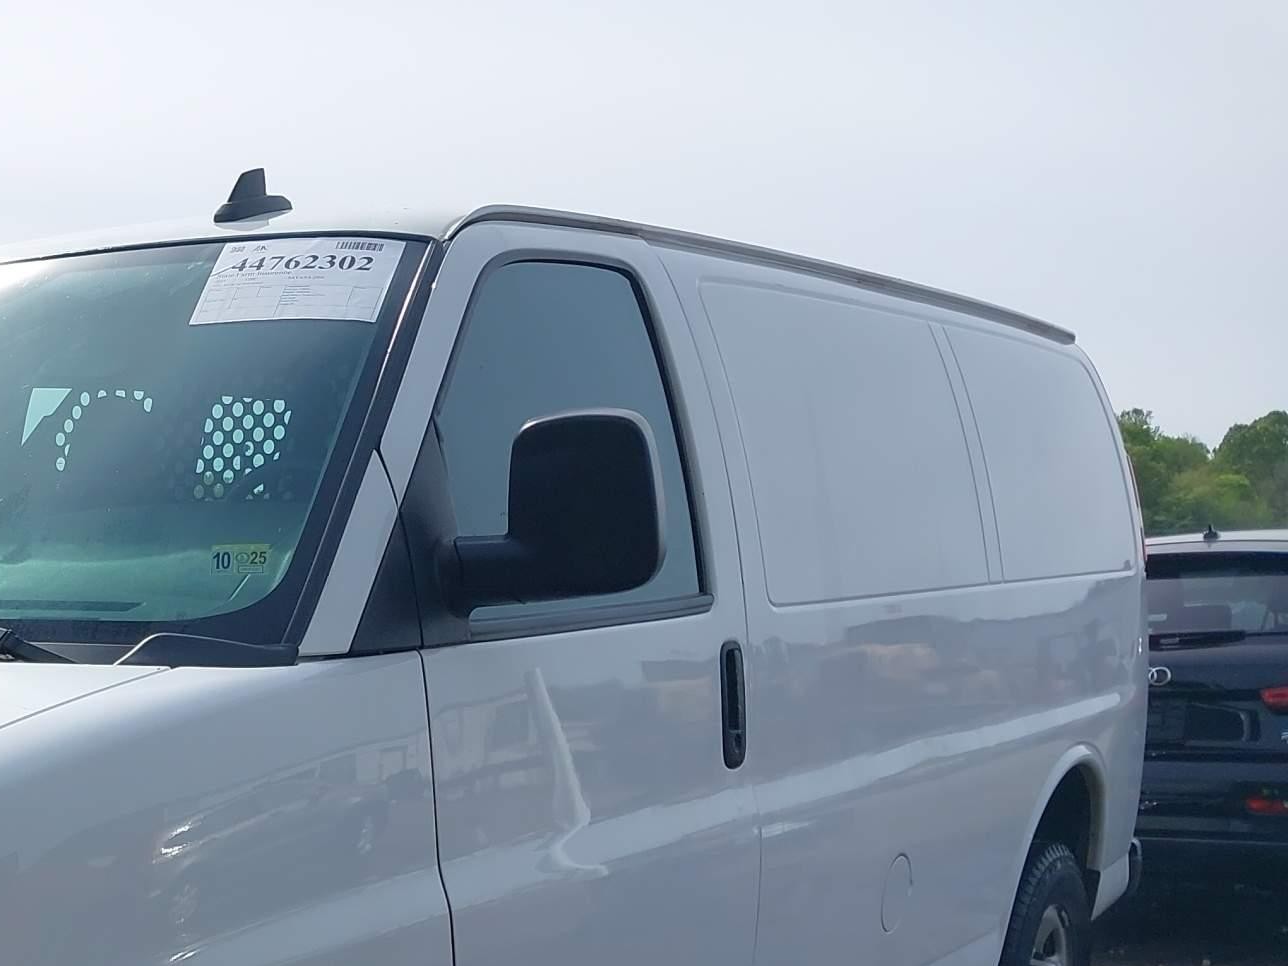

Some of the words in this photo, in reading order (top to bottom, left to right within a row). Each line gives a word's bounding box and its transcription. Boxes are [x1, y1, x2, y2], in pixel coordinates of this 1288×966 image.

[231, 254, 374, 271] 44762302
[212, 551, 231, 570] 10
[249, 551, 267, 565] 25
